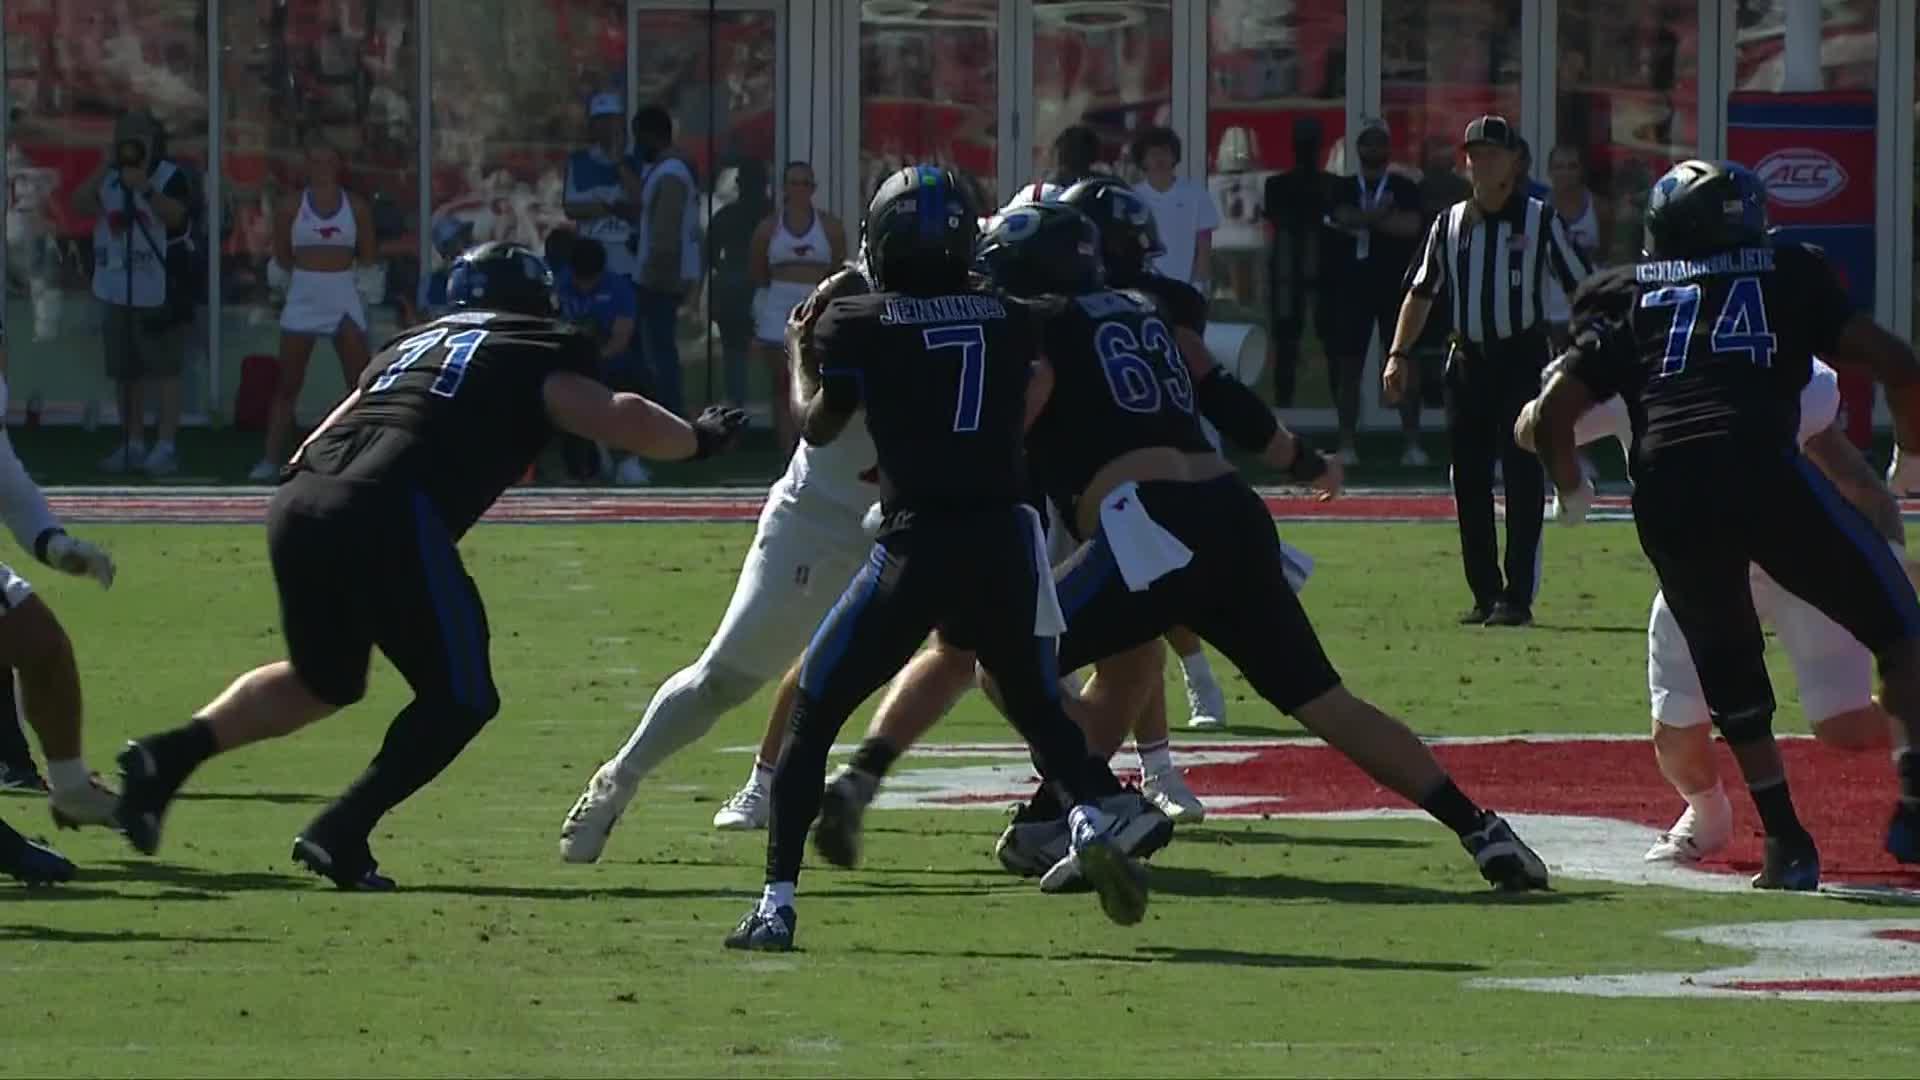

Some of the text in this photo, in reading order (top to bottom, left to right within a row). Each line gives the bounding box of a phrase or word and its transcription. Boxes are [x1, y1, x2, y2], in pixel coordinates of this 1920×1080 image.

[1766, 163, 1828, 188] ACC
[879, 295, 1005, 325] JENNINGS
[1640, 277, 1777, 377] 74
[369, 327, 490, 397] 71
[922, 324, 985, 432] 7
[1094, 317, 1193, 416] 63
